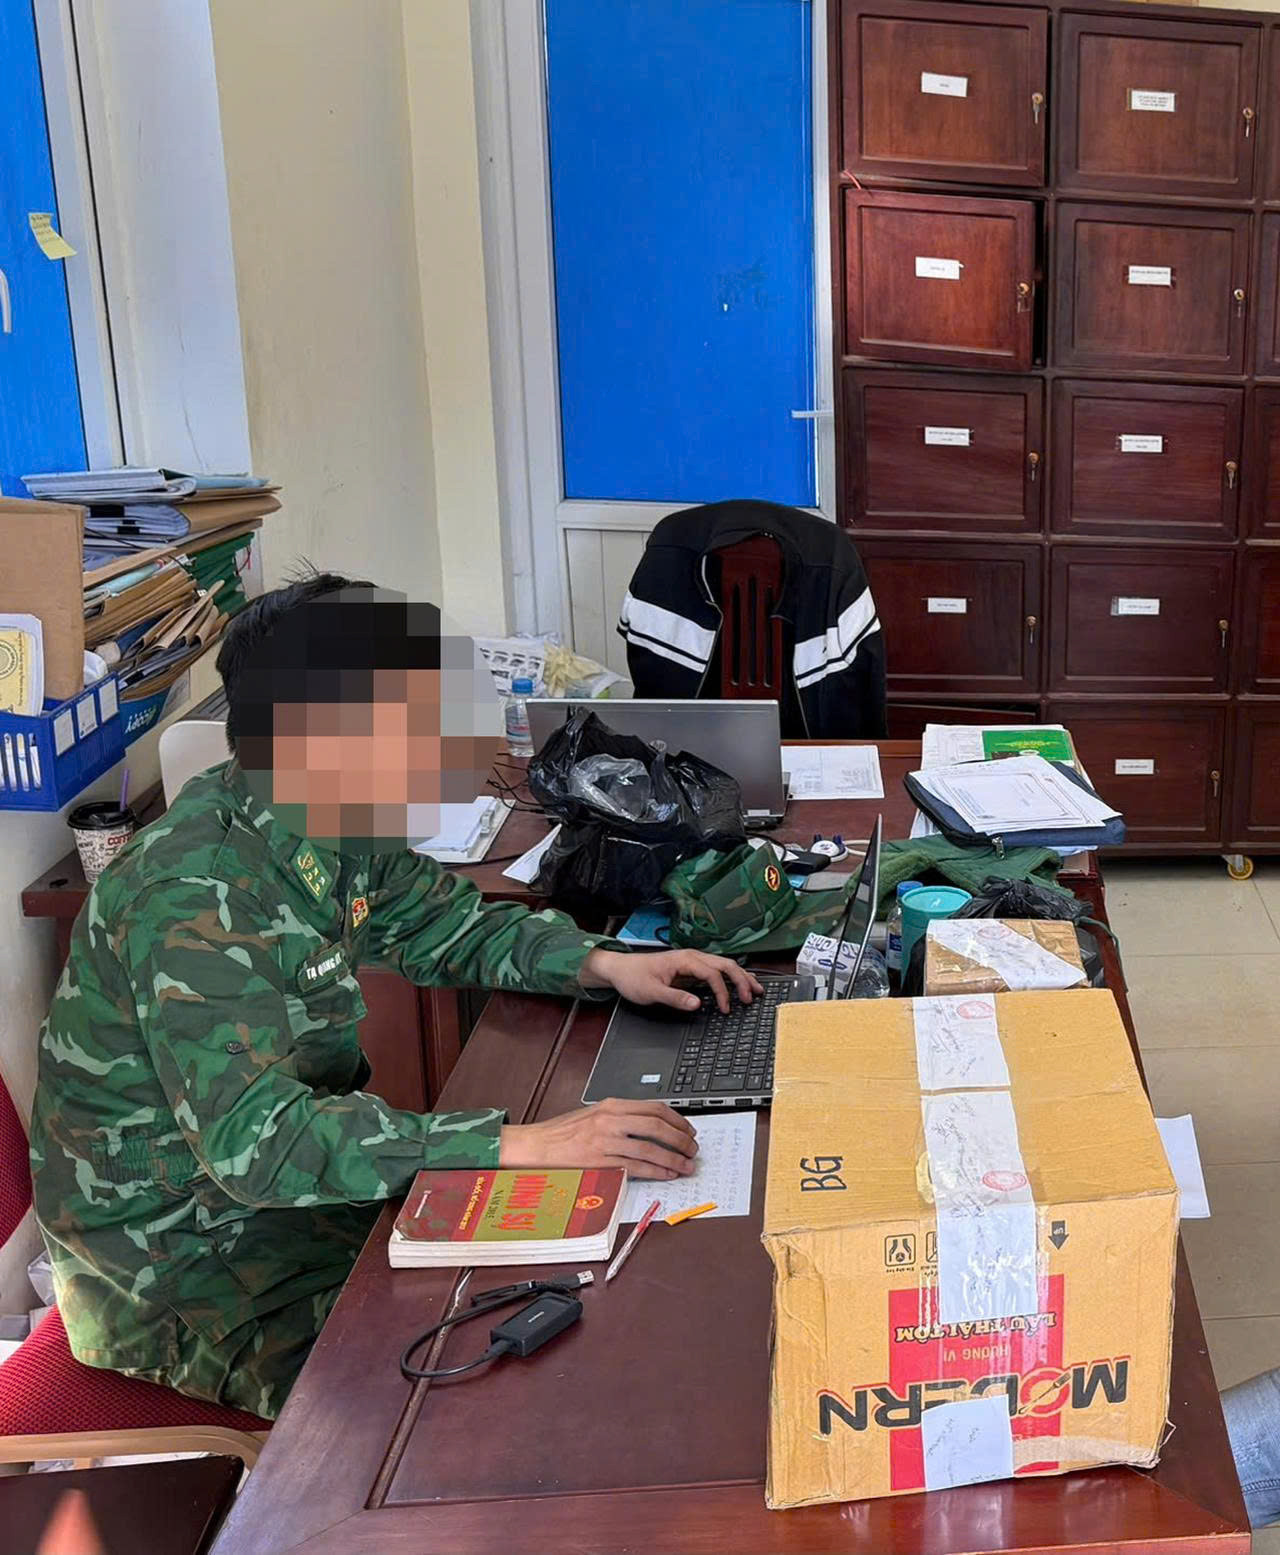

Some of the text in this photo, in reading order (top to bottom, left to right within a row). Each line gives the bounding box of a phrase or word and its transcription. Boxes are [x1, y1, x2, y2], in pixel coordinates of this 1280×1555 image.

[800, 1156, 847, 1192] BG
[895, 1324, 945, 1343] TÔM
[950, 1317, 1006, 1340] THÁI
